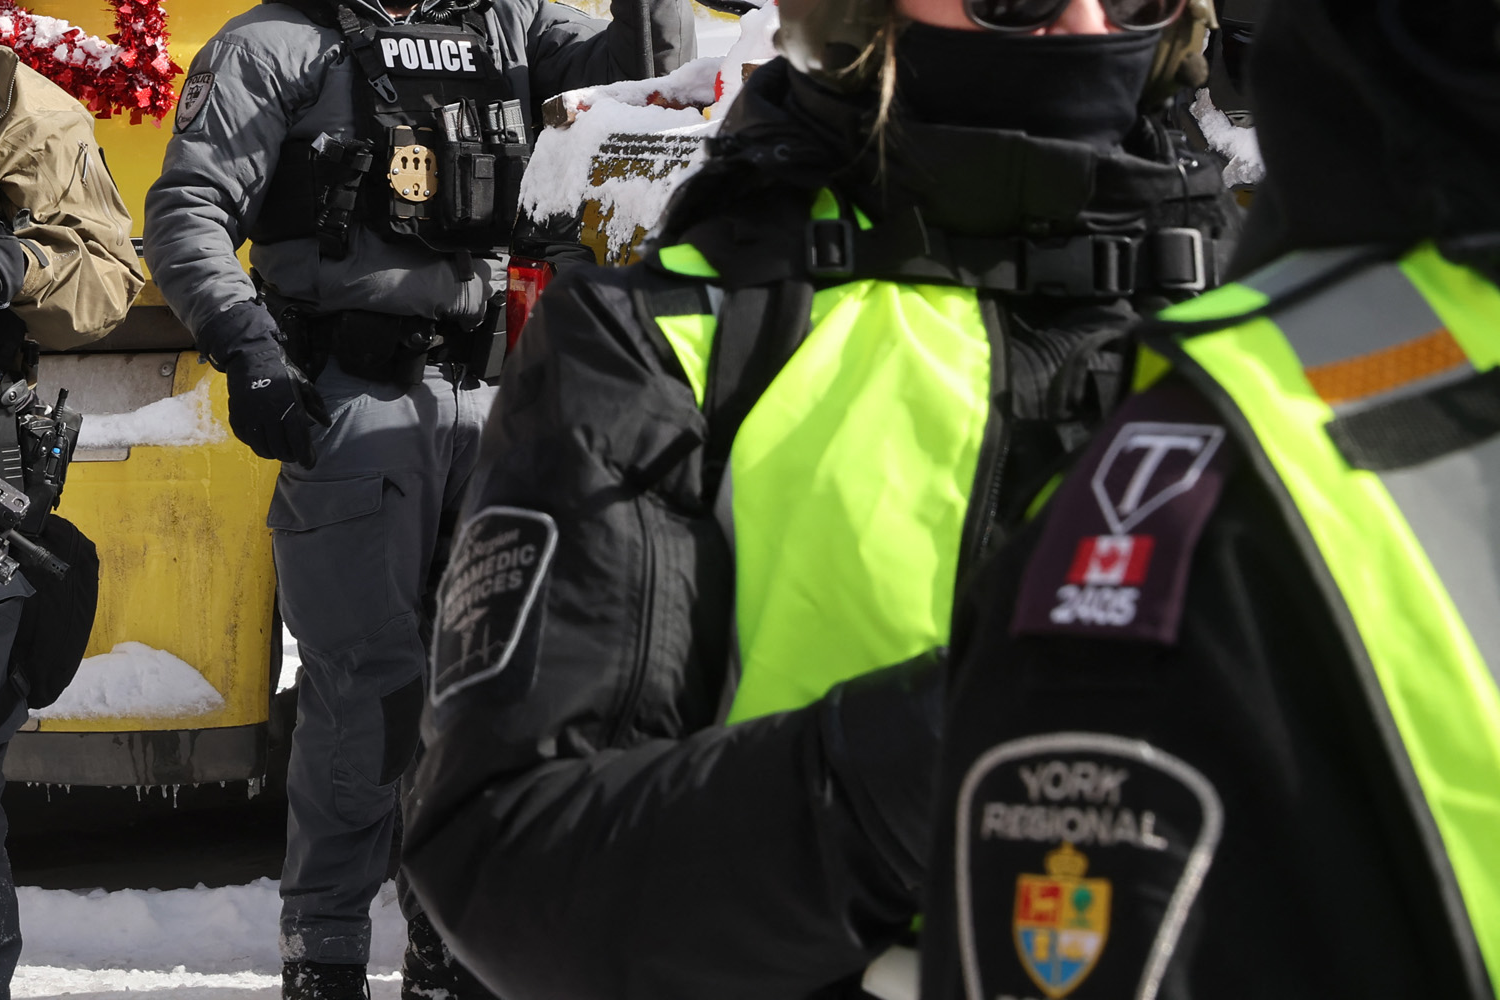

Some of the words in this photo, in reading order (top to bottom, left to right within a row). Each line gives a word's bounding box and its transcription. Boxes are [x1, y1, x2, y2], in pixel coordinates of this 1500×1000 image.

[380, 38, 476, 73] POLICE
[1017, 760, 1130, 806] YORK
[980, 802, 1168, 850] REGIONAL
